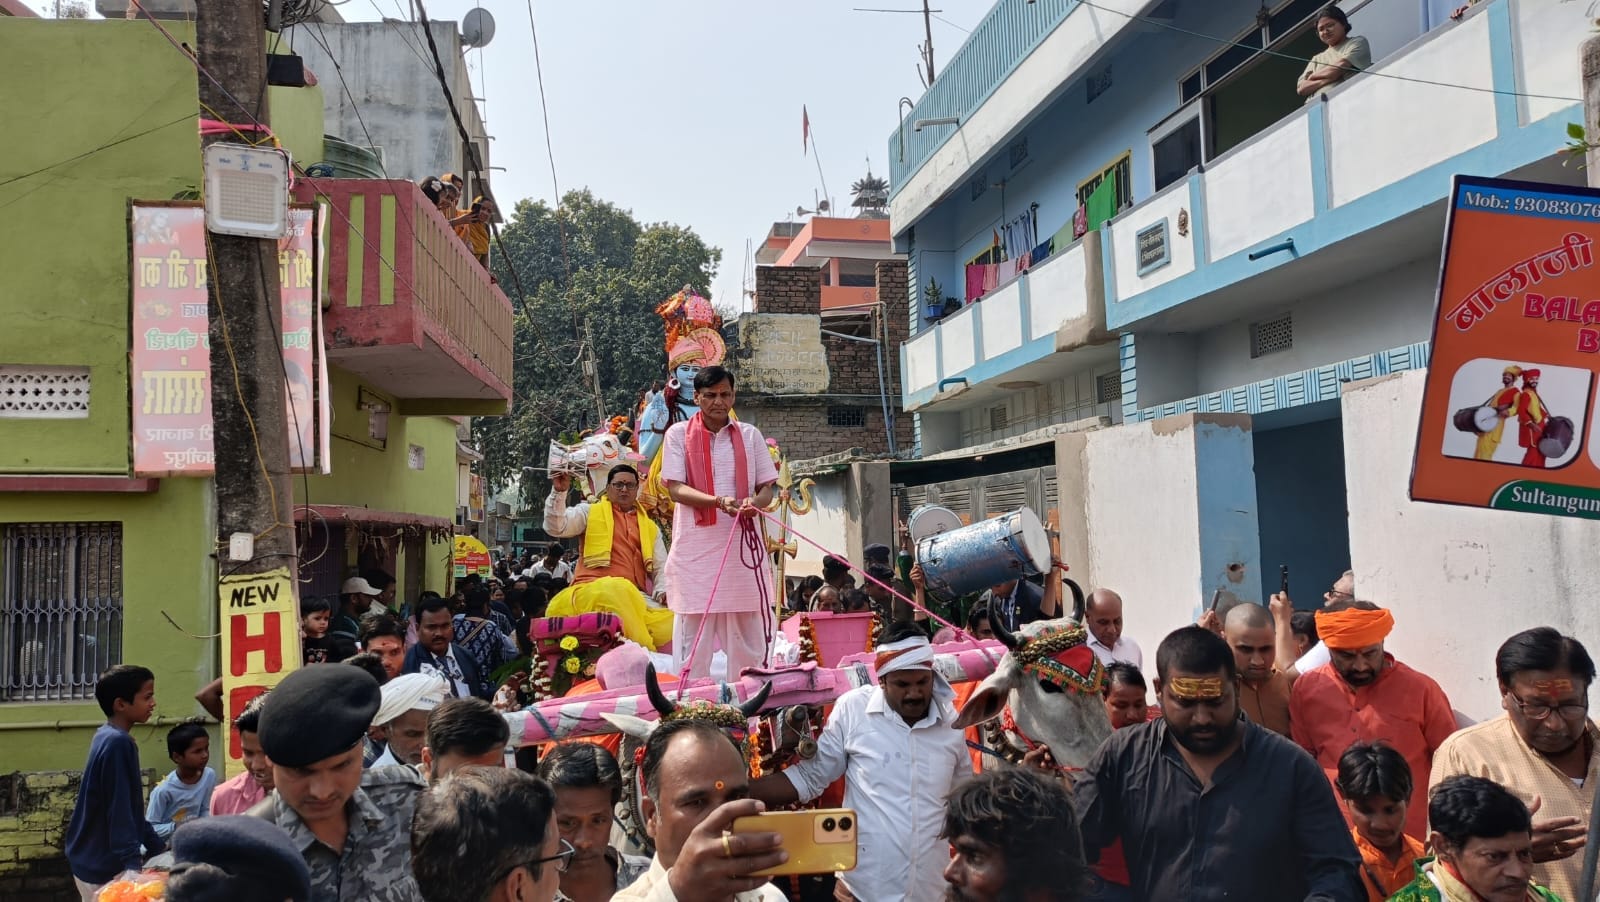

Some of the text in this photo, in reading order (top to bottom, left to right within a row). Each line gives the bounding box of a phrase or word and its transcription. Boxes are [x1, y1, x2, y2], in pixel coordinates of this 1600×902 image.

[1465, 191, 1510, 210] Mob.:
[1446, 232, 1592, 331] बालाजी
[230, 583, 280, 608] NEW
